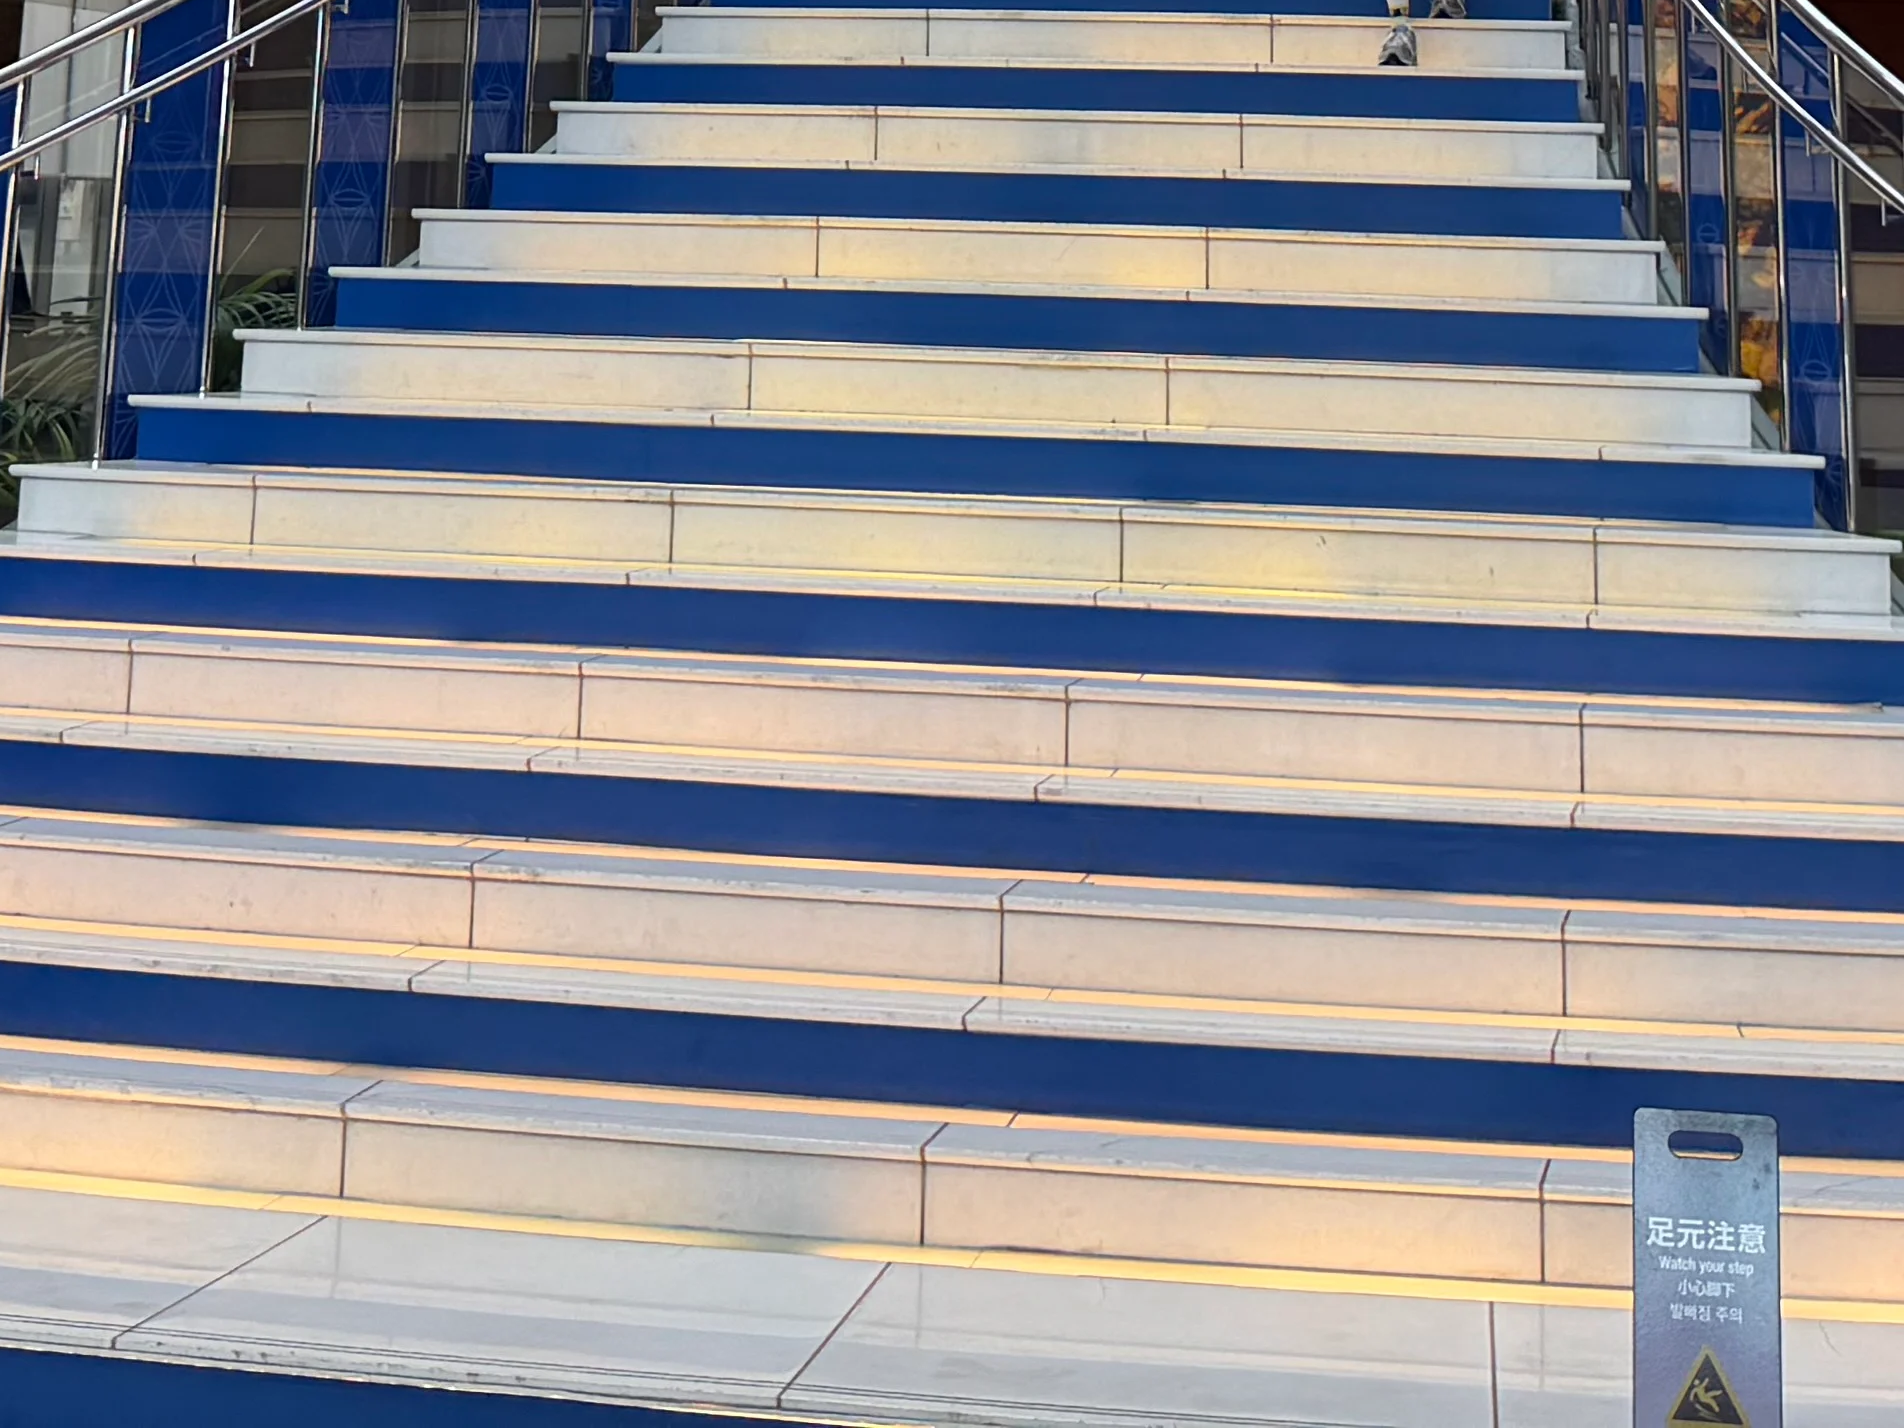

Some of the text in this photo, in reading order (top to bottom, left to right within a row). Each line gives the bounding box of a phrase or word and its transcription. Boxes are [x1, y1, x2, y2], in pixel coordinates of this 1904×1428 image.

[1647, 1217, 1765, 1254] 足元注意
[1658, 1255, 1754, 1278] Watch your step
[1716, 1306, 1742, 1324] 주의
